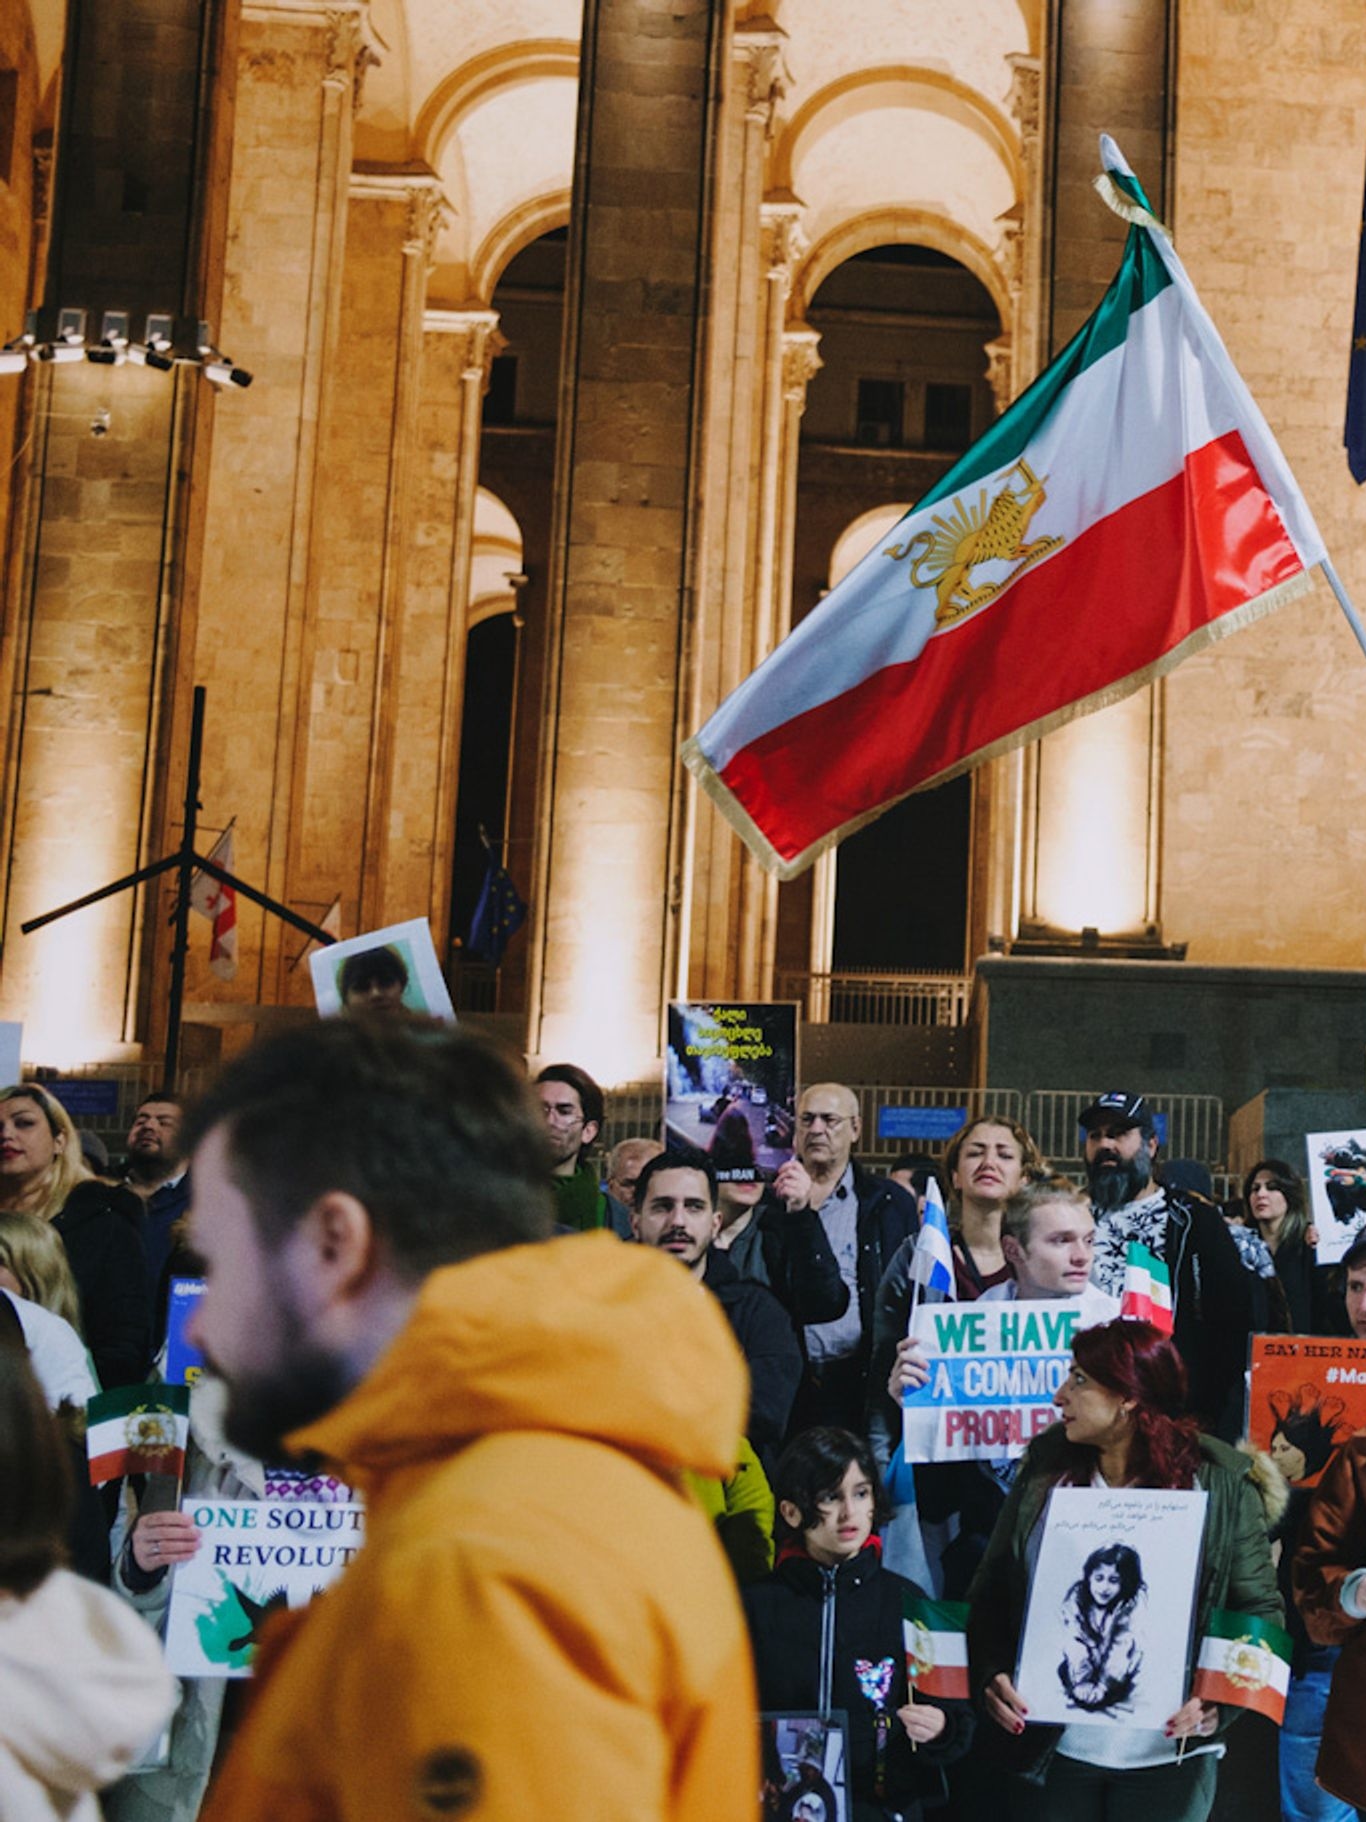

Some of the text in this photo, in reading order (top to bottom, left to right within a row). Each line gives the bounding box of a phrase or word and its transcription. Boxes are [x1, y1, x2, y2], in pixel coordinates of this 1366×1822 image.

[731, 1168, 755, 1181] IRAN
[934, 1311, 1081, 1353] WE HAVE
[1264, 1343, 1299, 1356] SAY
[1304, 1345, 1342, 1358] HER
[931, 1358, 1071, 1399] A COMMO
[946, 1408, 1057, 1447] PROBLE
[193, 1506, 257, 1529] ONE
